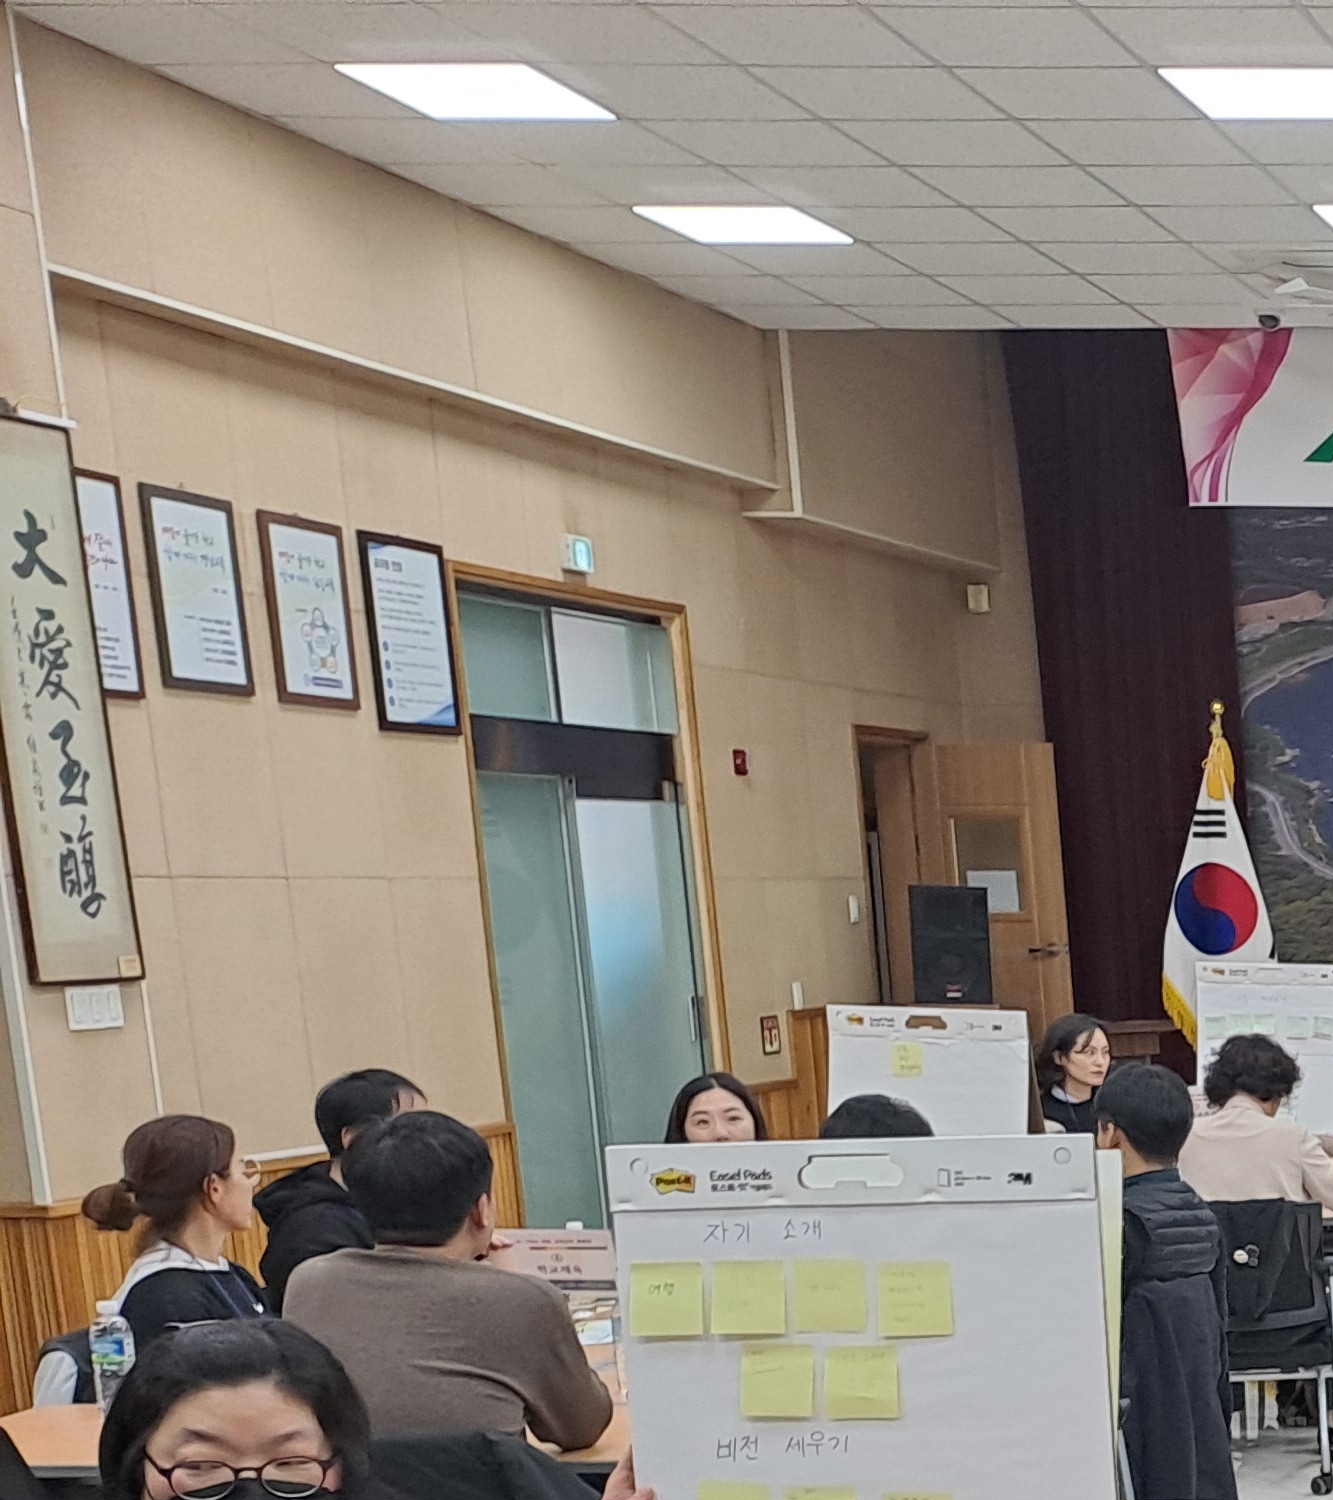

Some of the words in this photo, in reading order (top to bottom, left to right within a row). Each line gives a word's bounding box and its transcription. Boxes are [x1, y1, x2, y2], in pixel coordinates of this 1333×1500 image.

[702, 1220, 750, 1244] 자기
[783, 1218, 823, 1241] 소개
[716, 1435, 759, 1462] 비전
[785, 1431, 849, 1458] 세우기
